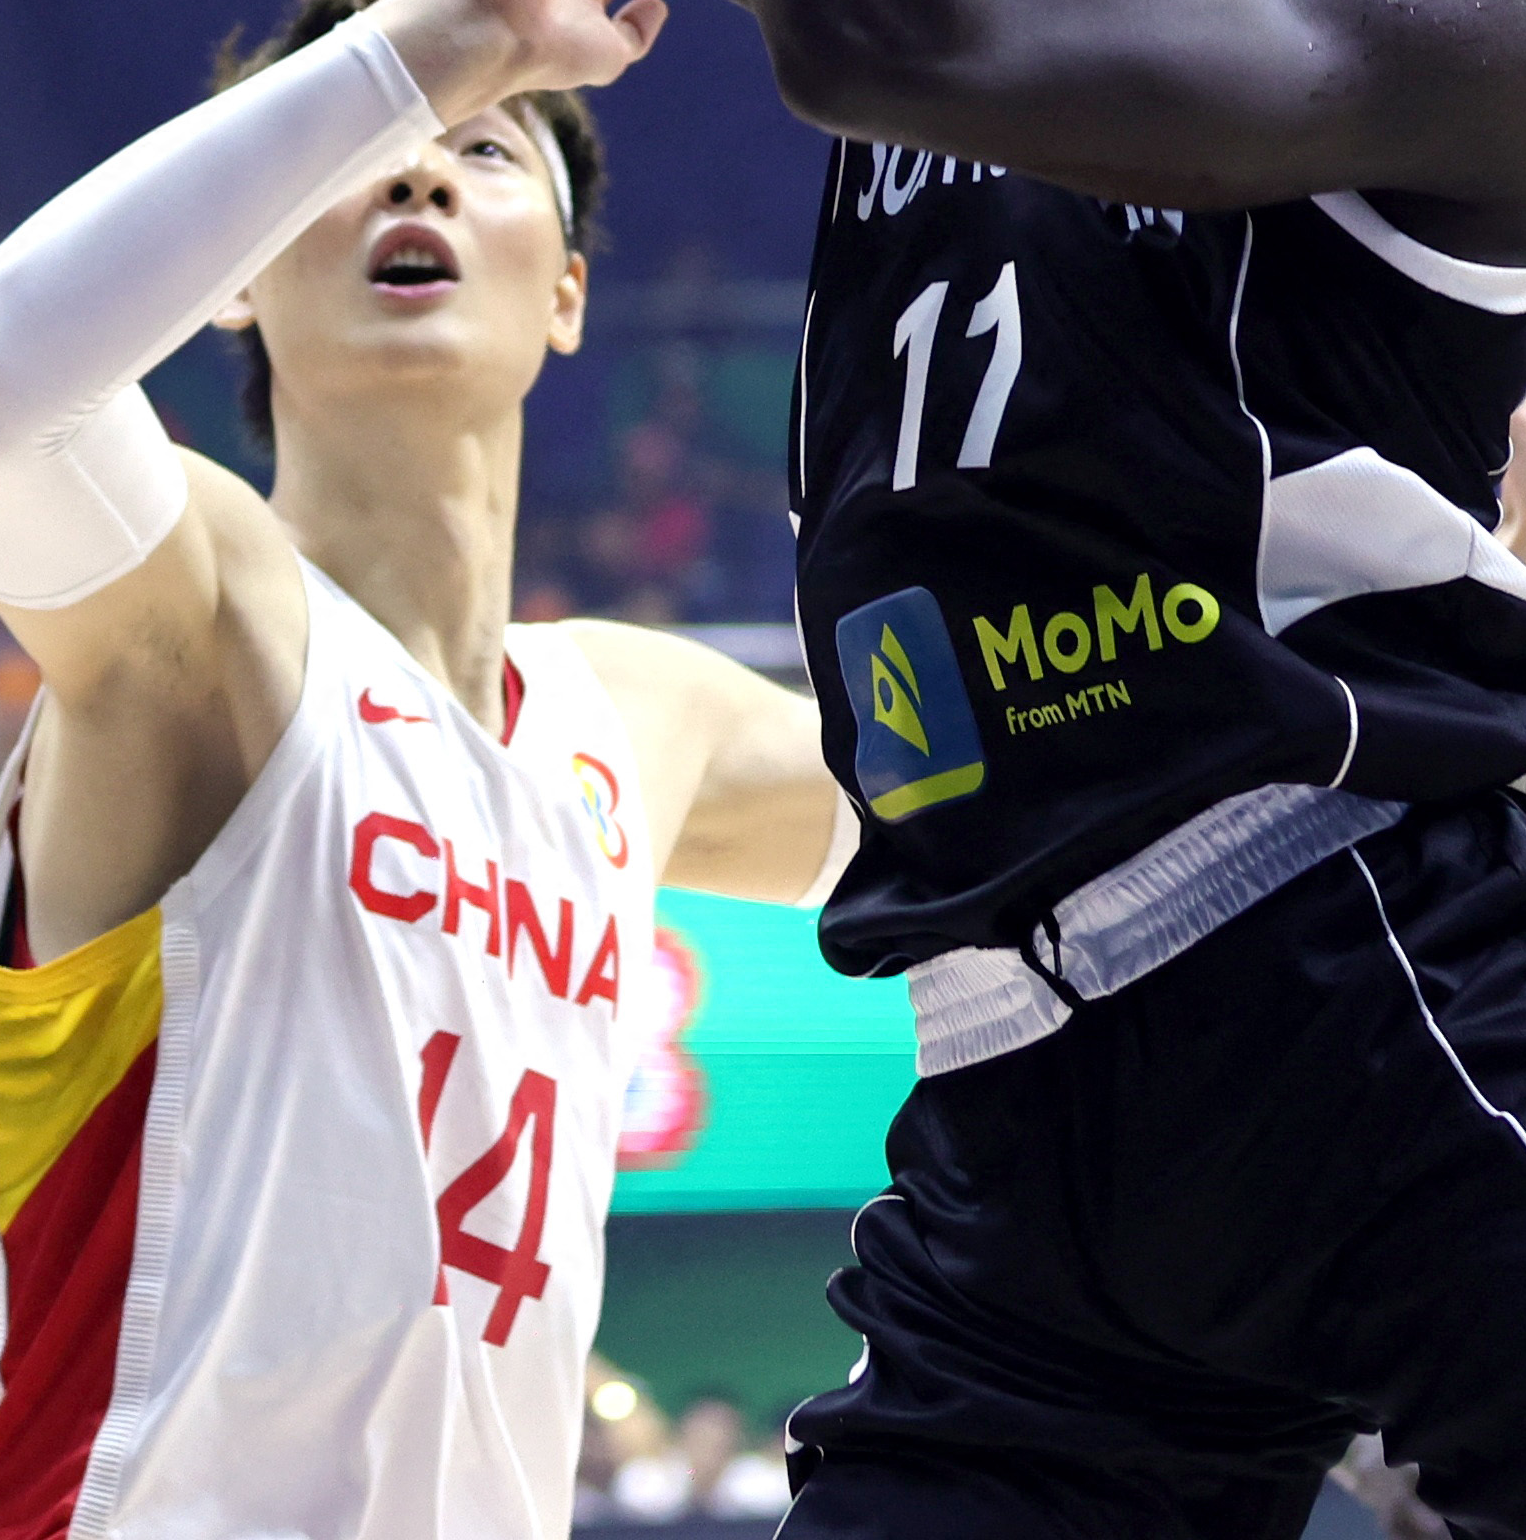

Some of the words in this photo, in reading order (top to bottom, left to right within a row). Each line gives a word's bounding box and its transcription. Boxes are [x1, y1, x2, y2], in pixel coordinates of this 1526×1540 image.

[893, 260, 1022, 492] 11
[1006, 706, 1065, 735] from
[1065, 679, 1131, 720] MTN
[348, 811, 620, 1022] CHNA
[418, 1031, 557, 1347] 14
